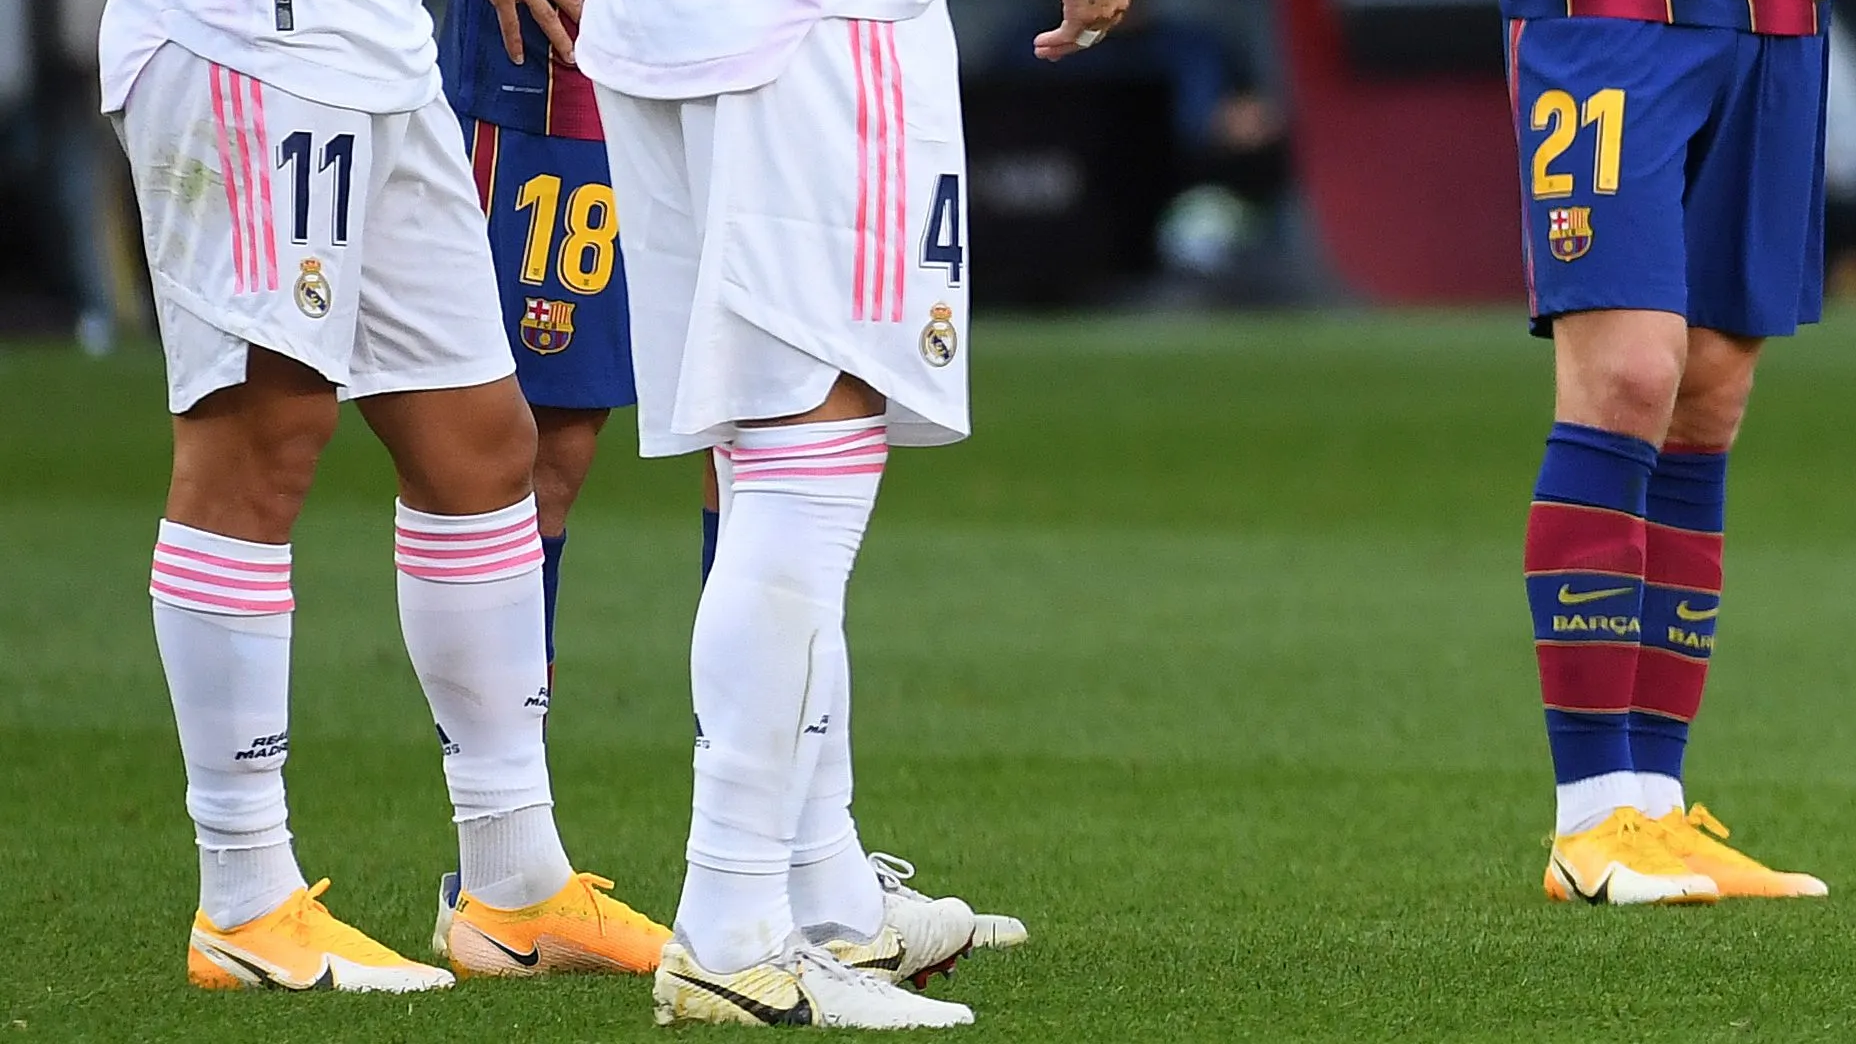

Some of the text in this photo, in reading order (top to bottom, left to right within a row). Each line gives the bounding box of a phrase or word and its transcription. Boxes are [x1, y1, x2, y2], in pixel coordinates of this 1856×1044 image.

[276, 131, 355, 246] 11
[1531, 88, 1626, 200] 21
[515, 173, 620, 295] 18
[919, 174, 963, 288] 4
[1668, 625, 1714, 650] BAR
[252, 732, 287, 747] REA
